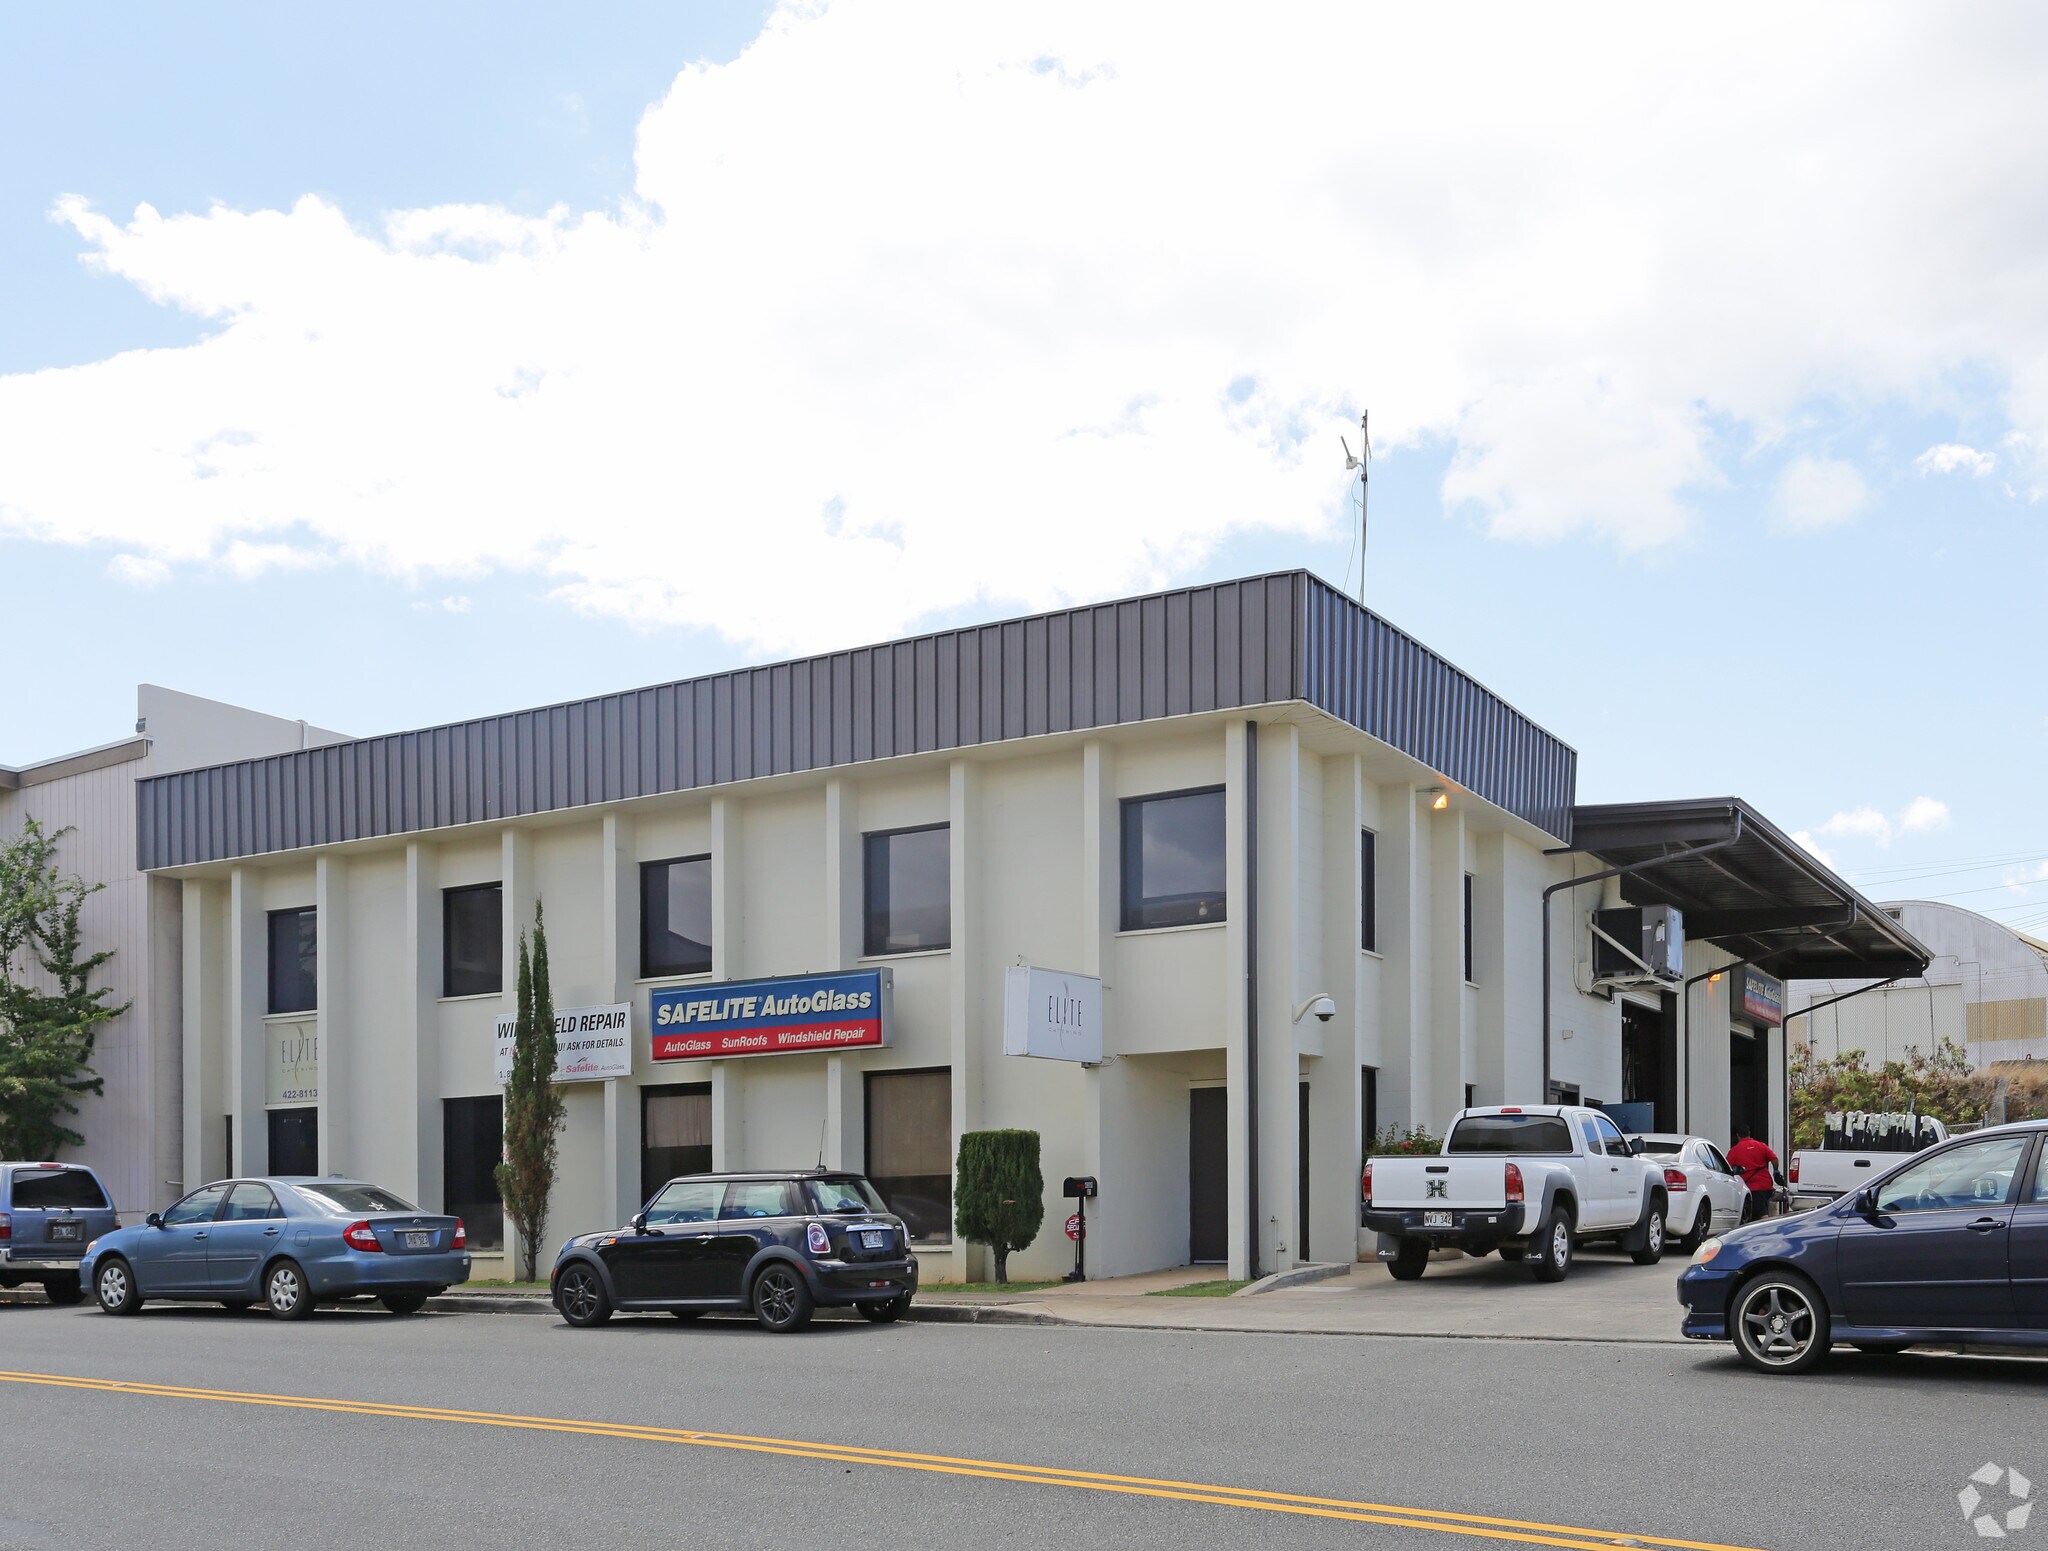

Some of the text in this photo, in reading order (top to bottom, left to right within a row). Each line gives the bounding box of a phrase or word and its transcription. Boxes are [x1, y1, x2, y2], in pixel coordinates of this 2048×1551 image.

[657, 989, 872, 1025] SAFELITE AutoGlass
[1048, 995, 1082, 1027] ELITE
[580, 1012, 626, 1032] REPAIR
[282, 1037, 318, 1063] ELITE
[567, 1041, 581, 1051] ASK
[582, 1040, 595, 1050] FOR
[596, 1038, 625, 1049] DETAILS.
[664, 1027, 866, 1053] AutoGlass SunRoofs Windshield Repair
[499, 1047, 508, 1056] AT
[566, 1063, 599, 1073] Safelite
[282, 1088, 318, 1099] 422-8113
